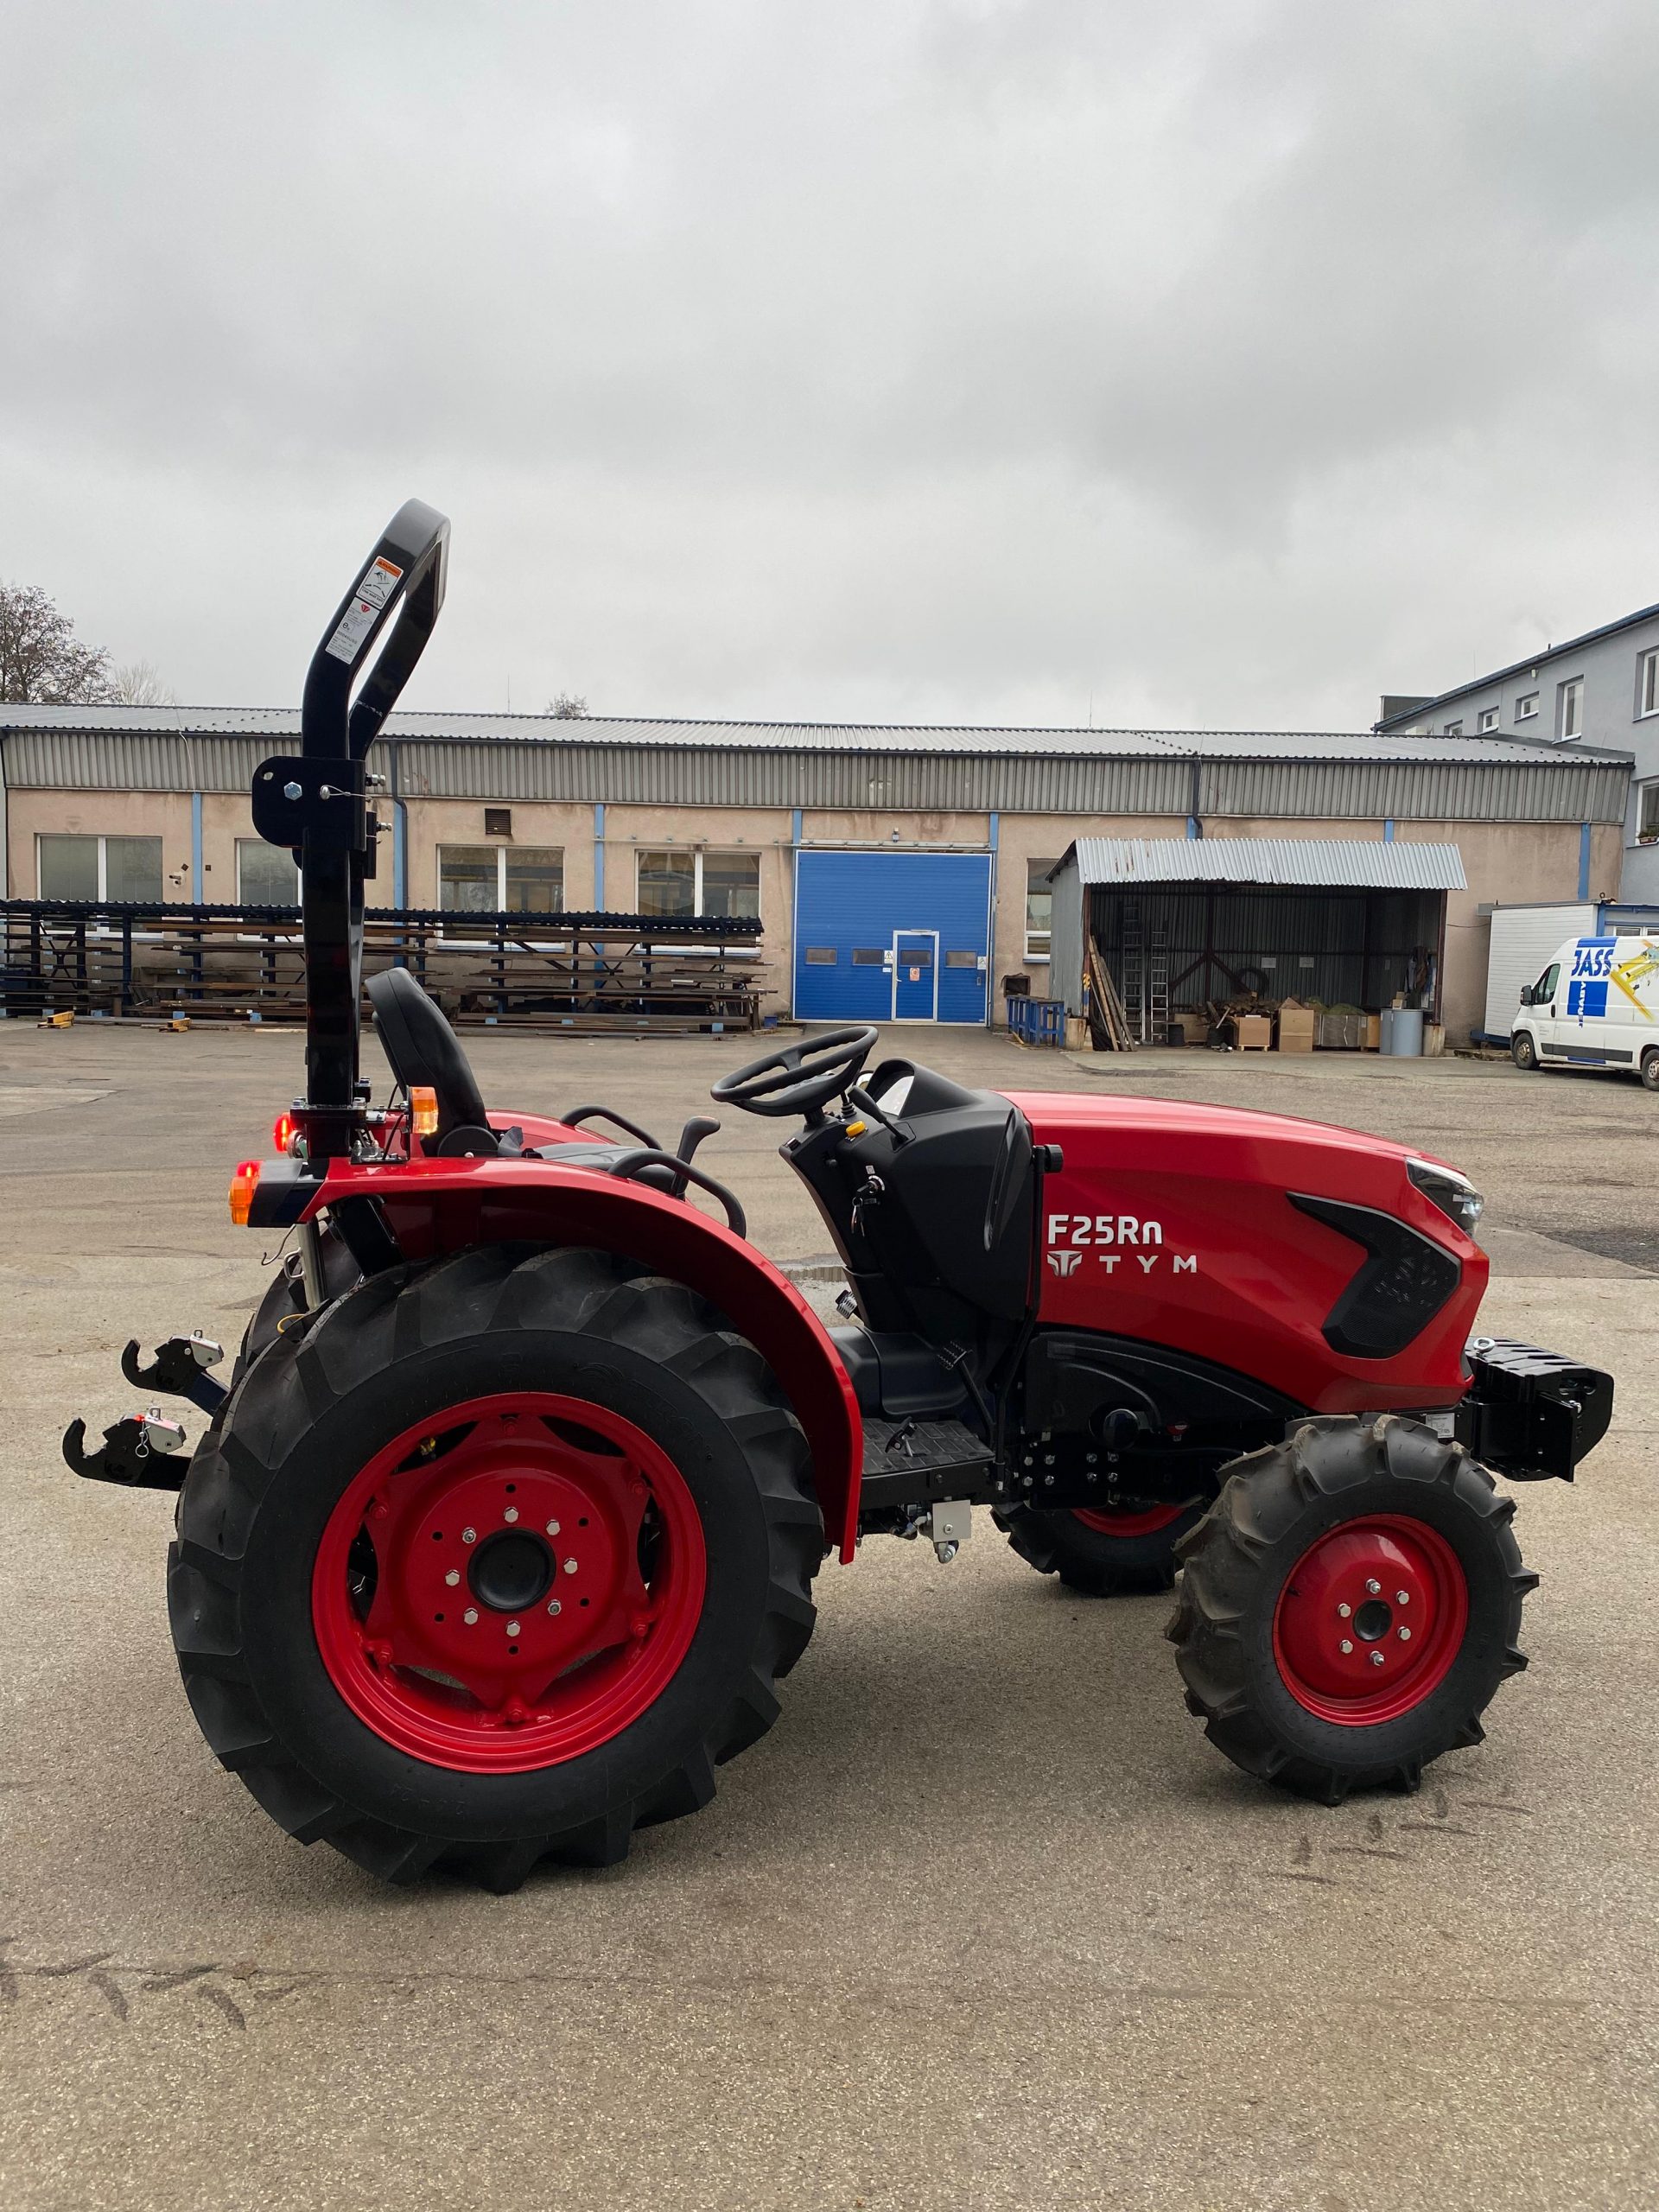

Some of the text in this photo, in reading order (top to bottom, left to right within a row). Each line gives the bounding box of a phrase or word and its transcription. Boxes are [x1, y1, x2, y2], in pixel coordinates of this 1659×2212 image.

[1571, 949, 1614, 976] JASS
[1047, 1214, 1163, 1245] F25Rn
[1098, 1255, 1198, 1274] TYM
